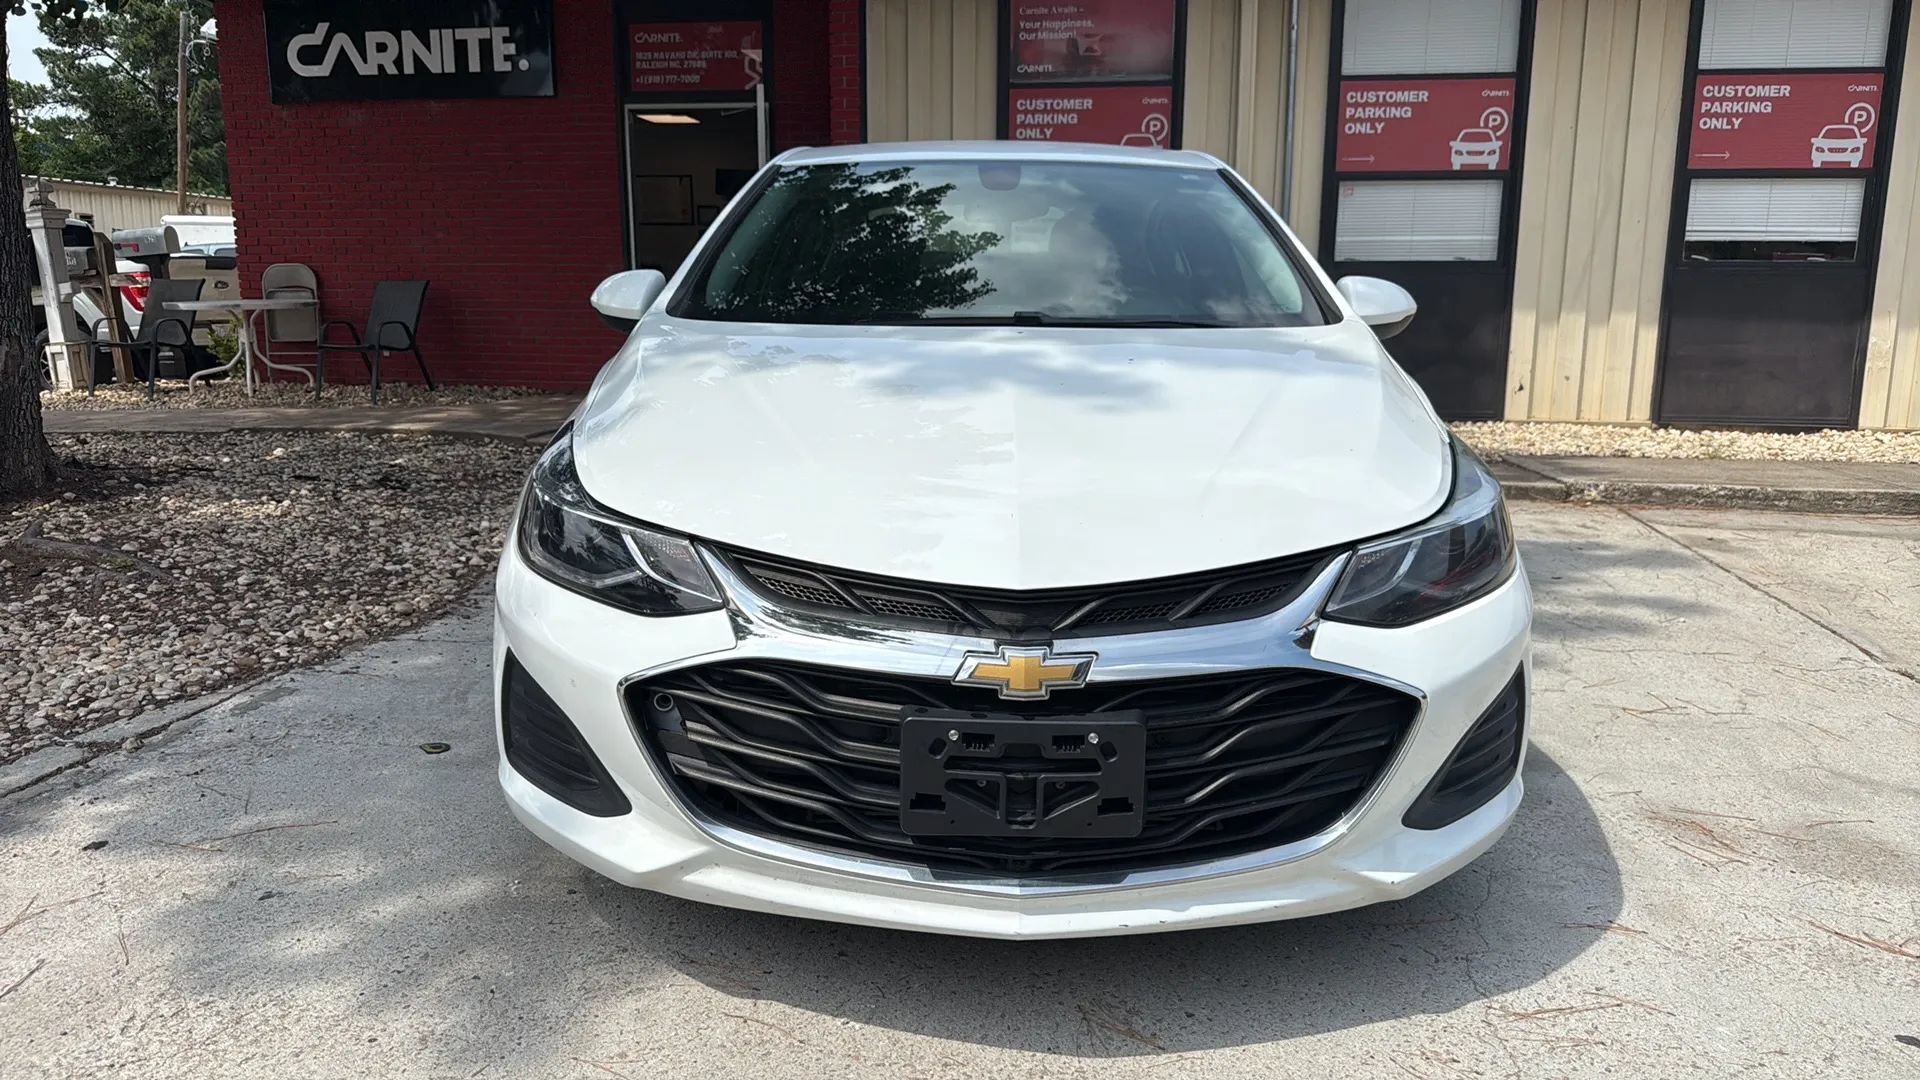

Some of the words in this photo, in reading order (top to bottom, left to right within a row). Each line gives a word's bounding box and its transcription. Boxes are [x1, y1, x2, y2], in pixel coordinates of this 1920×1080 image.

[1019, 20, 1041, 30] Your
[1019, 31, 1036, 40] Our
[1037, 29, 1077, 40] Mission!
[1346, 91, 1428, 103] CUSTOMER
[1703, 85, 1790, 97] CUSTOMER
[1016, 99, 1093, 110] CUSTOMER
[1701, 101, 1772, 113] PARKING
[1346, 107, 1412, 119] PARKING
[1016, 114, 1078, 125] PARKING
[1699, 117, 1743, 130] ONLY
[1016, 128, 1053, 139] ONLY
[1344, 122, 1385, 135] ONLY
